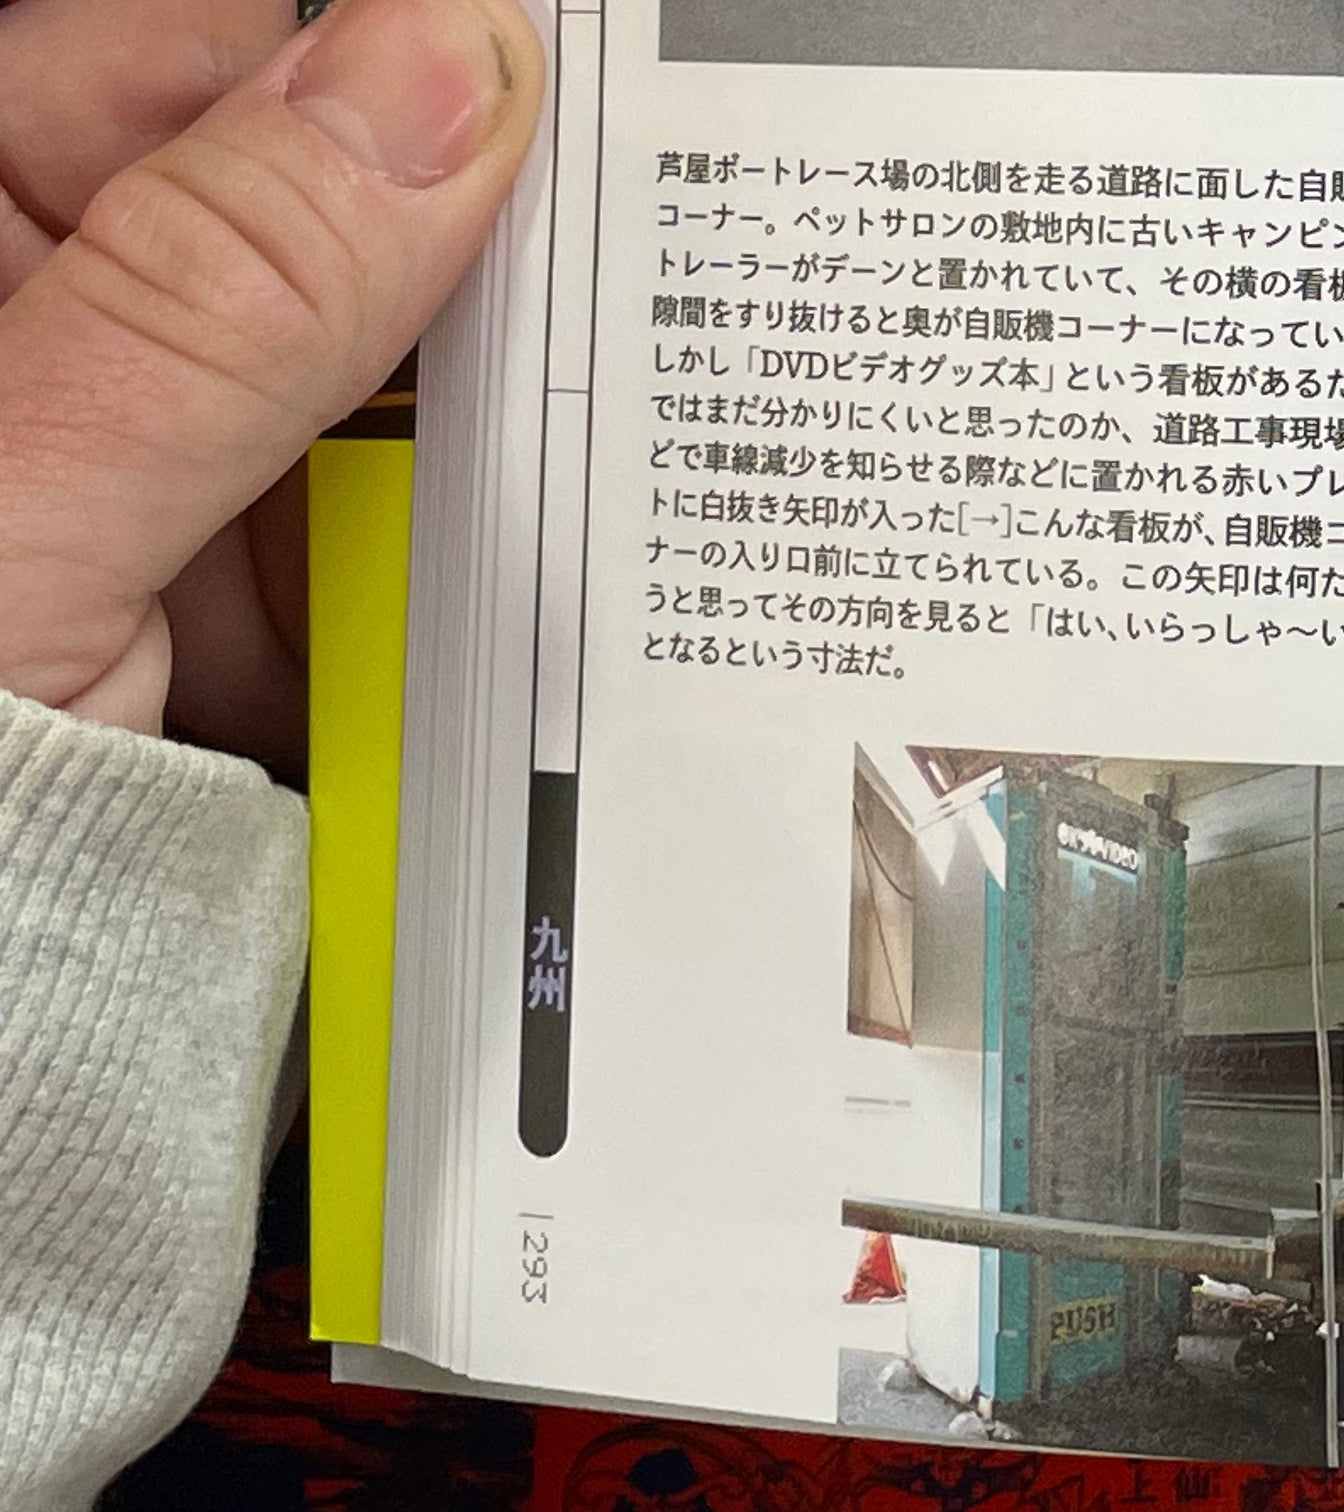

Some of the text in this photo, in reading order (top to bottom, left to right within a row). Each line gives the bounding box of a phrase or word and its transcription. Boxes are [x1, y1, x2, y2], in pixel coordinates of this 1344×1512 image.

[643, 631, 906, 680] となるという寸法だ。
[528, 915, 569, 1012] 九州
[521, 1230, 550, 1305] 293
